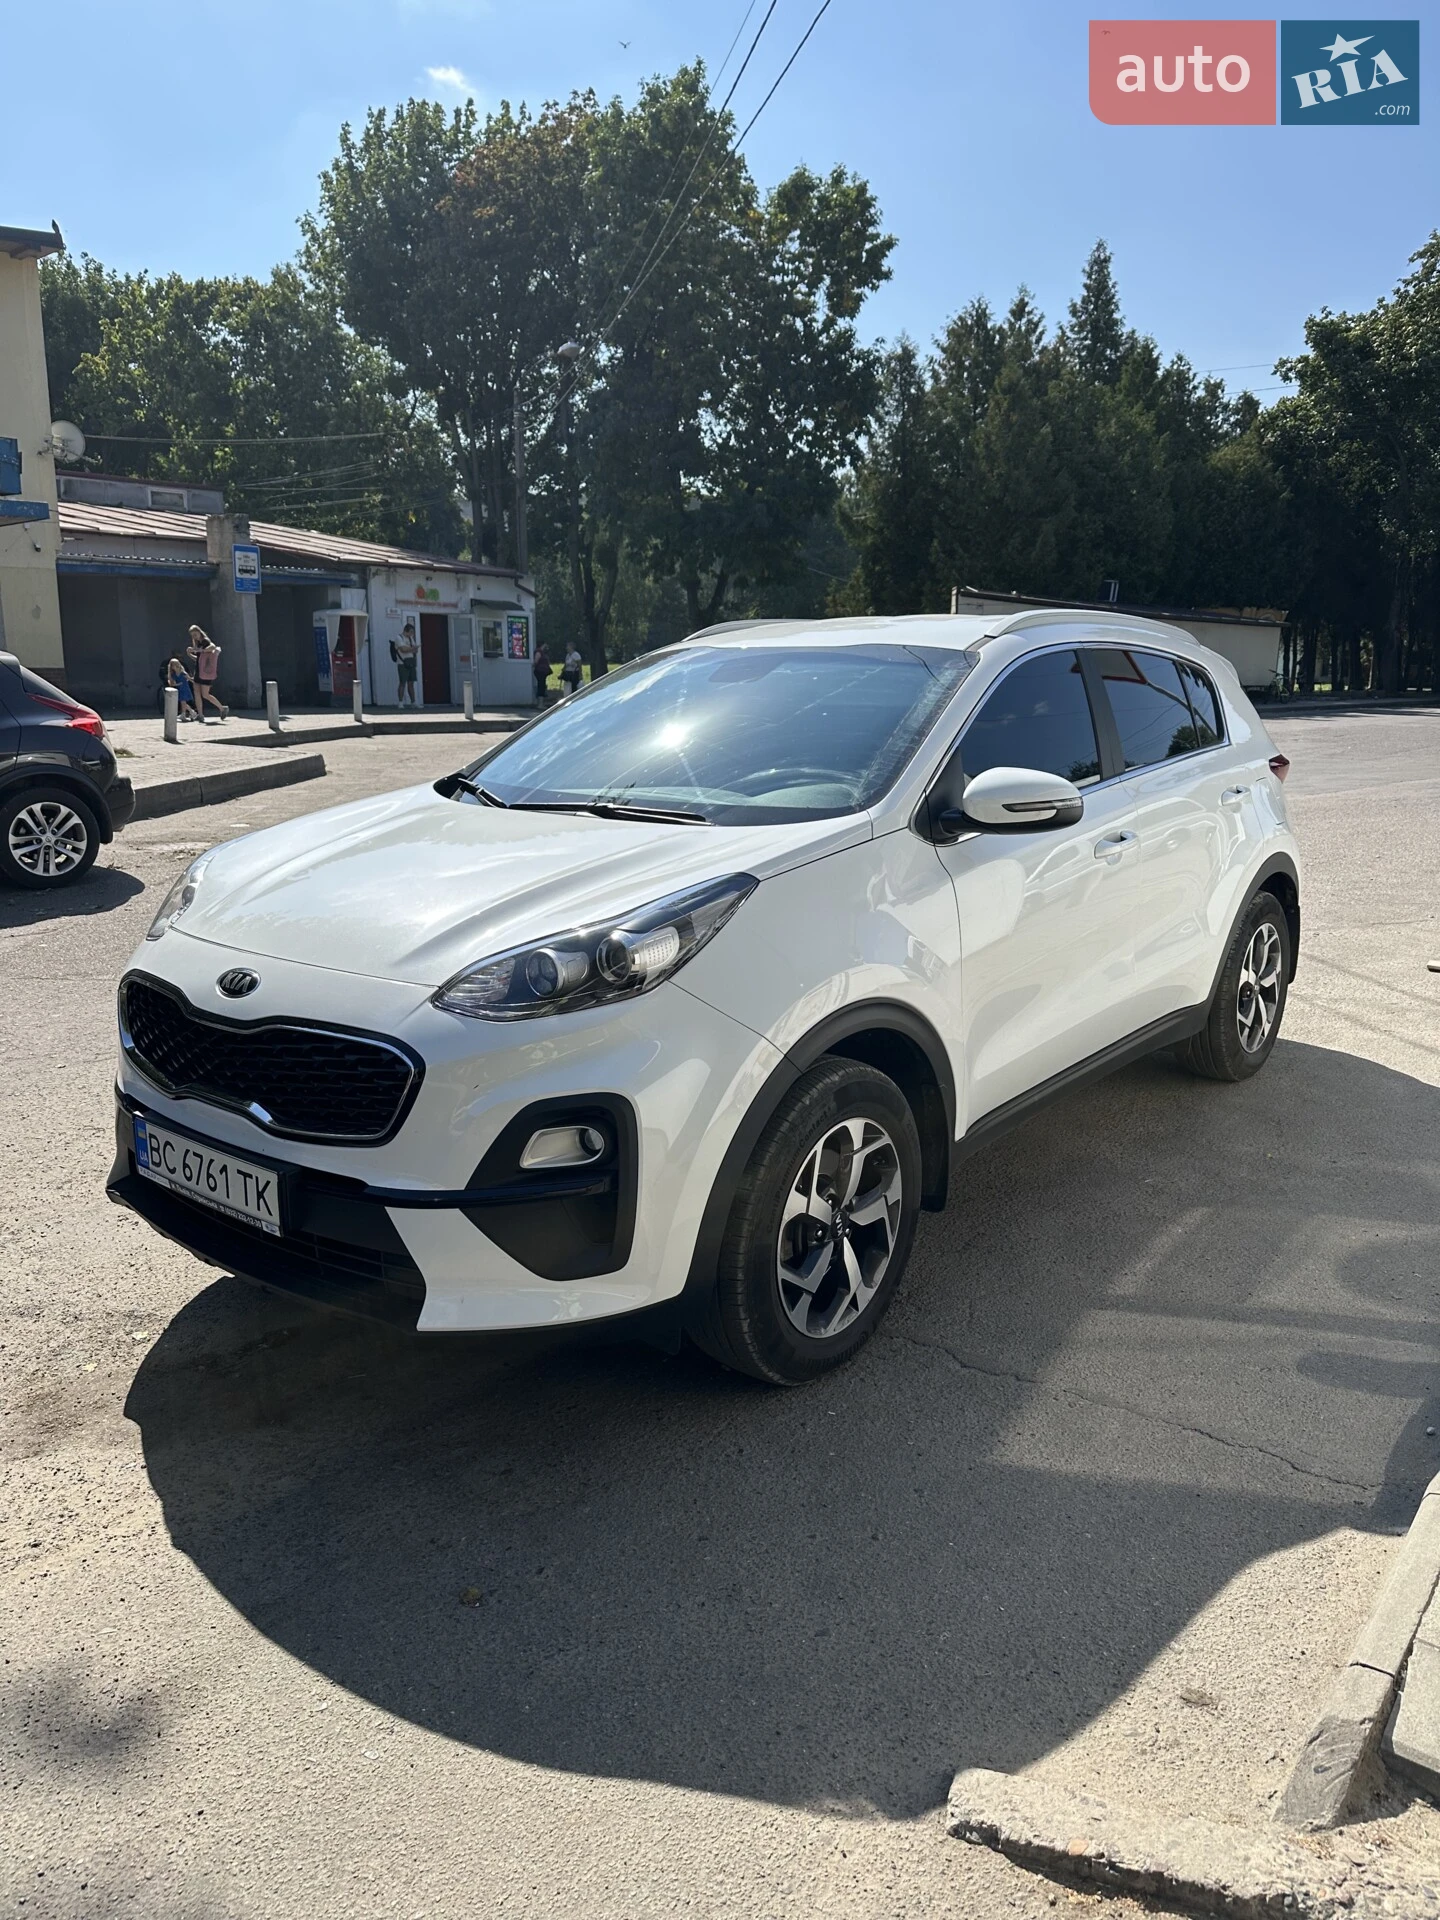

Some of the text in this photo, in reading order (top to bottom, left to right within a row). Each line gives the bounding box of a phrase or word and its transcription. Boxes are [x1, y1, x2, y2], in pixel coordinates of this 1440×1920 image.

[221, 972, 252, 993] KIA
[139, 1151, 149, 1162] UA
[148, 1132, 177, 1175] BC
[182, 1148, 230, 1199] 6761
[236, 1168, 273, 1217] TK
[835, 1214, 844, 1237] KIA
